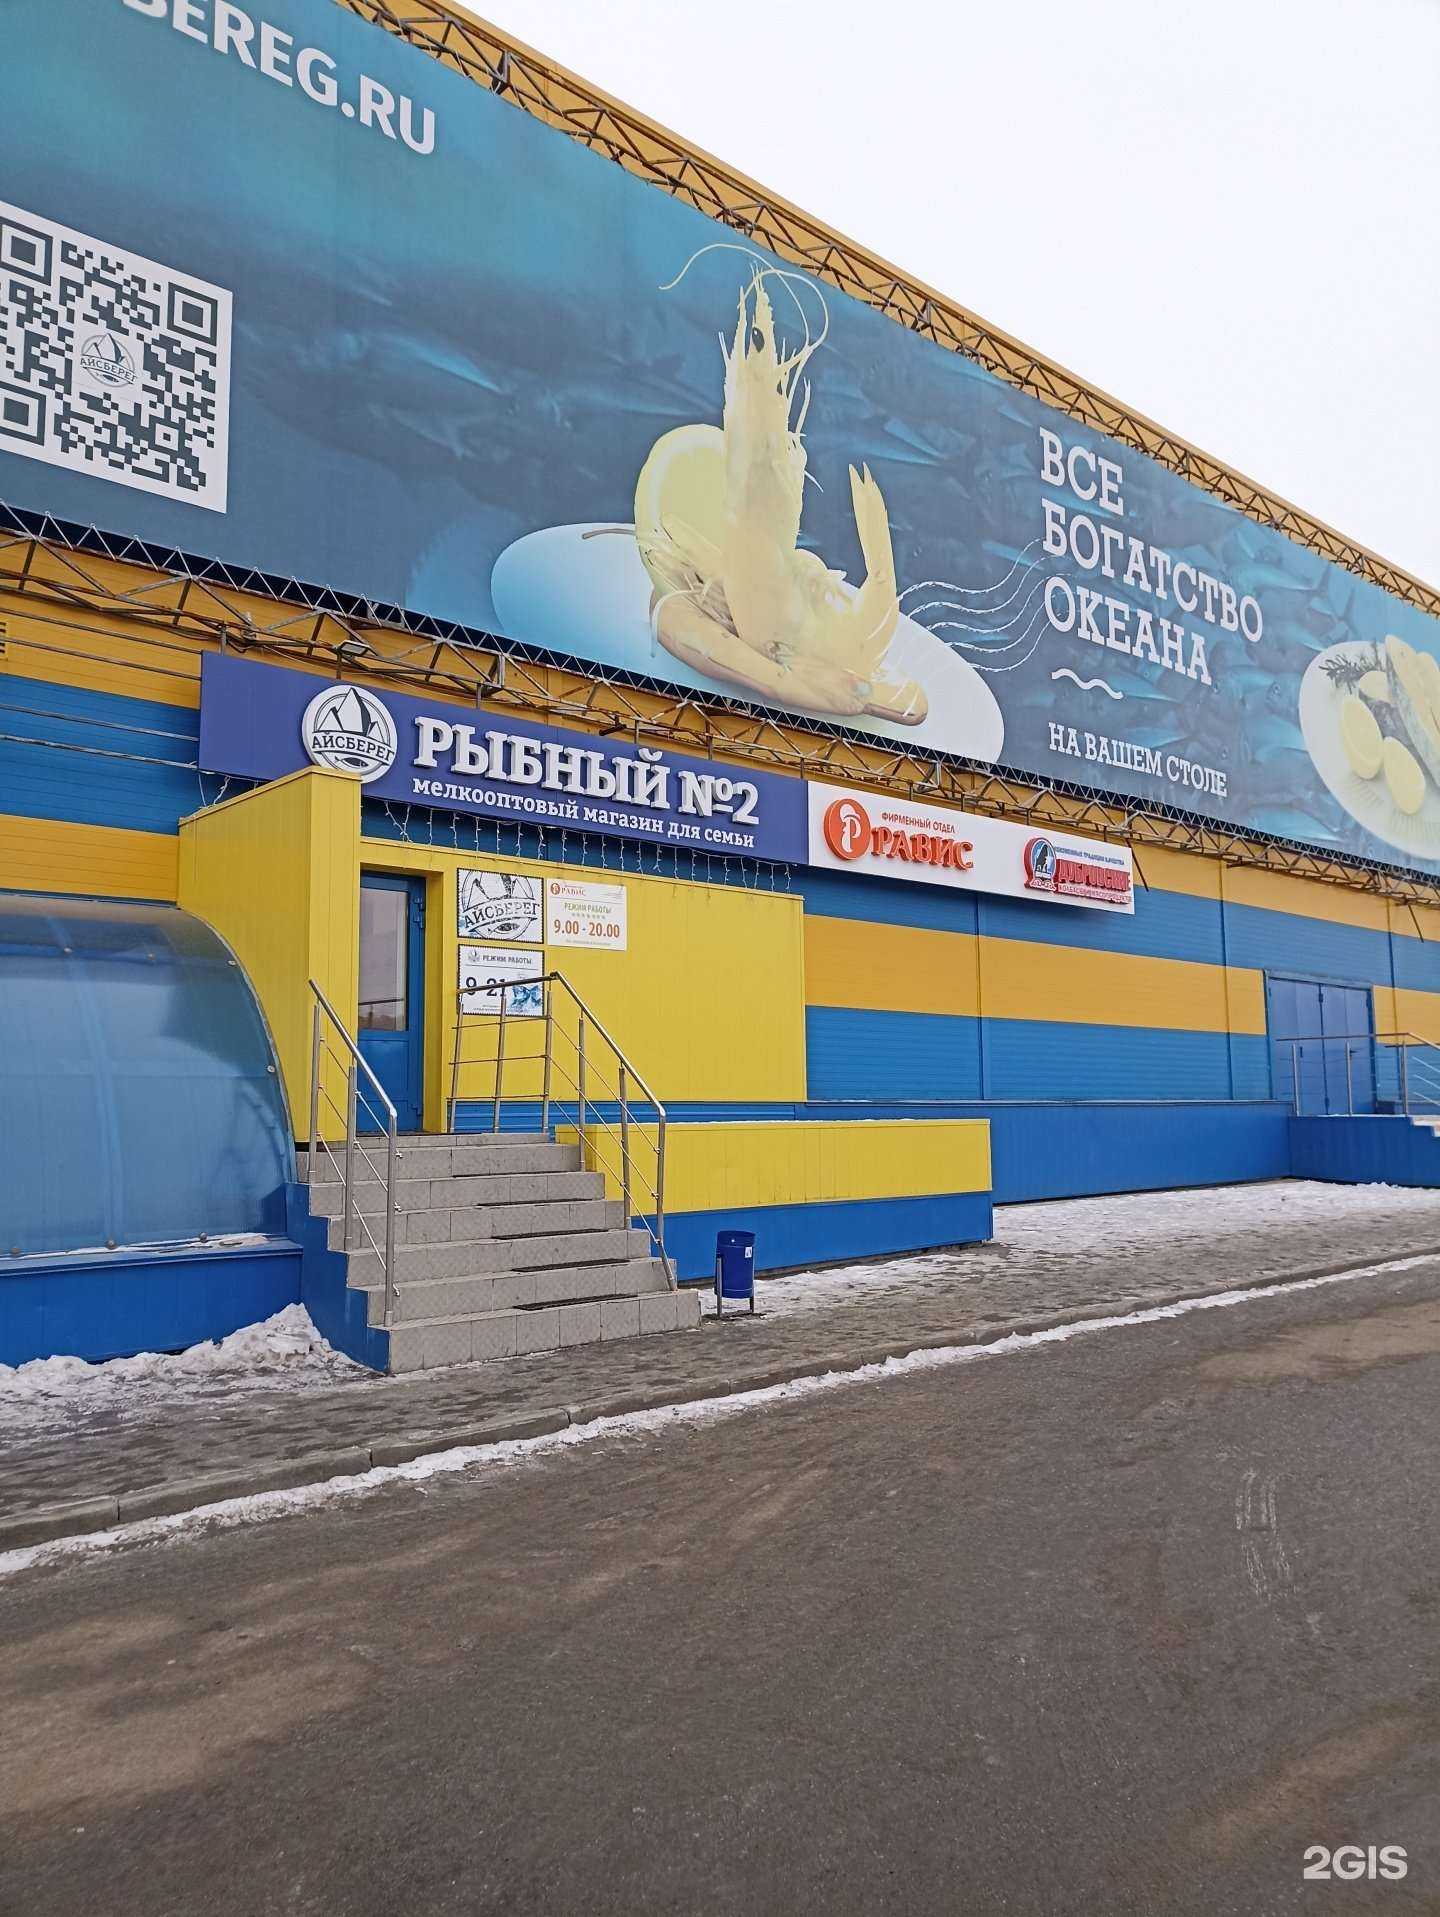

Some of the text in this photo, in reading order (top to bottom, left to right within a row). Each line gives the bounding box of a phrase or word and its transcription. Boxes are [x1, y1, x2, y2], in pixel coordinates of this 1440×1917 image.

[1040, 427, 1124, 516] ВСЕ
[1041, 498, 1263, 642] БОГАТСТВО
[1044, 576, 1213, 686] ОКЕАНА
[312, 732, 395, 762] АЙСБЕРЕГ
[413, 716, 760, 825] РЫБНЫЙ №2
[1049, 722, 1227, 797] НА ВАШЕМ СТОЛЕ
[412, 777, 755, 848] мелкооптовый магазин для семьи
[870, 826, 974, 871] РАВИС
[881, 812, 956, 834] ФИРМЕННЫЙ ОТДЕЛ
[554, 919, 579, 935] 9.00
[589, 921, 620, 938] 20.00
